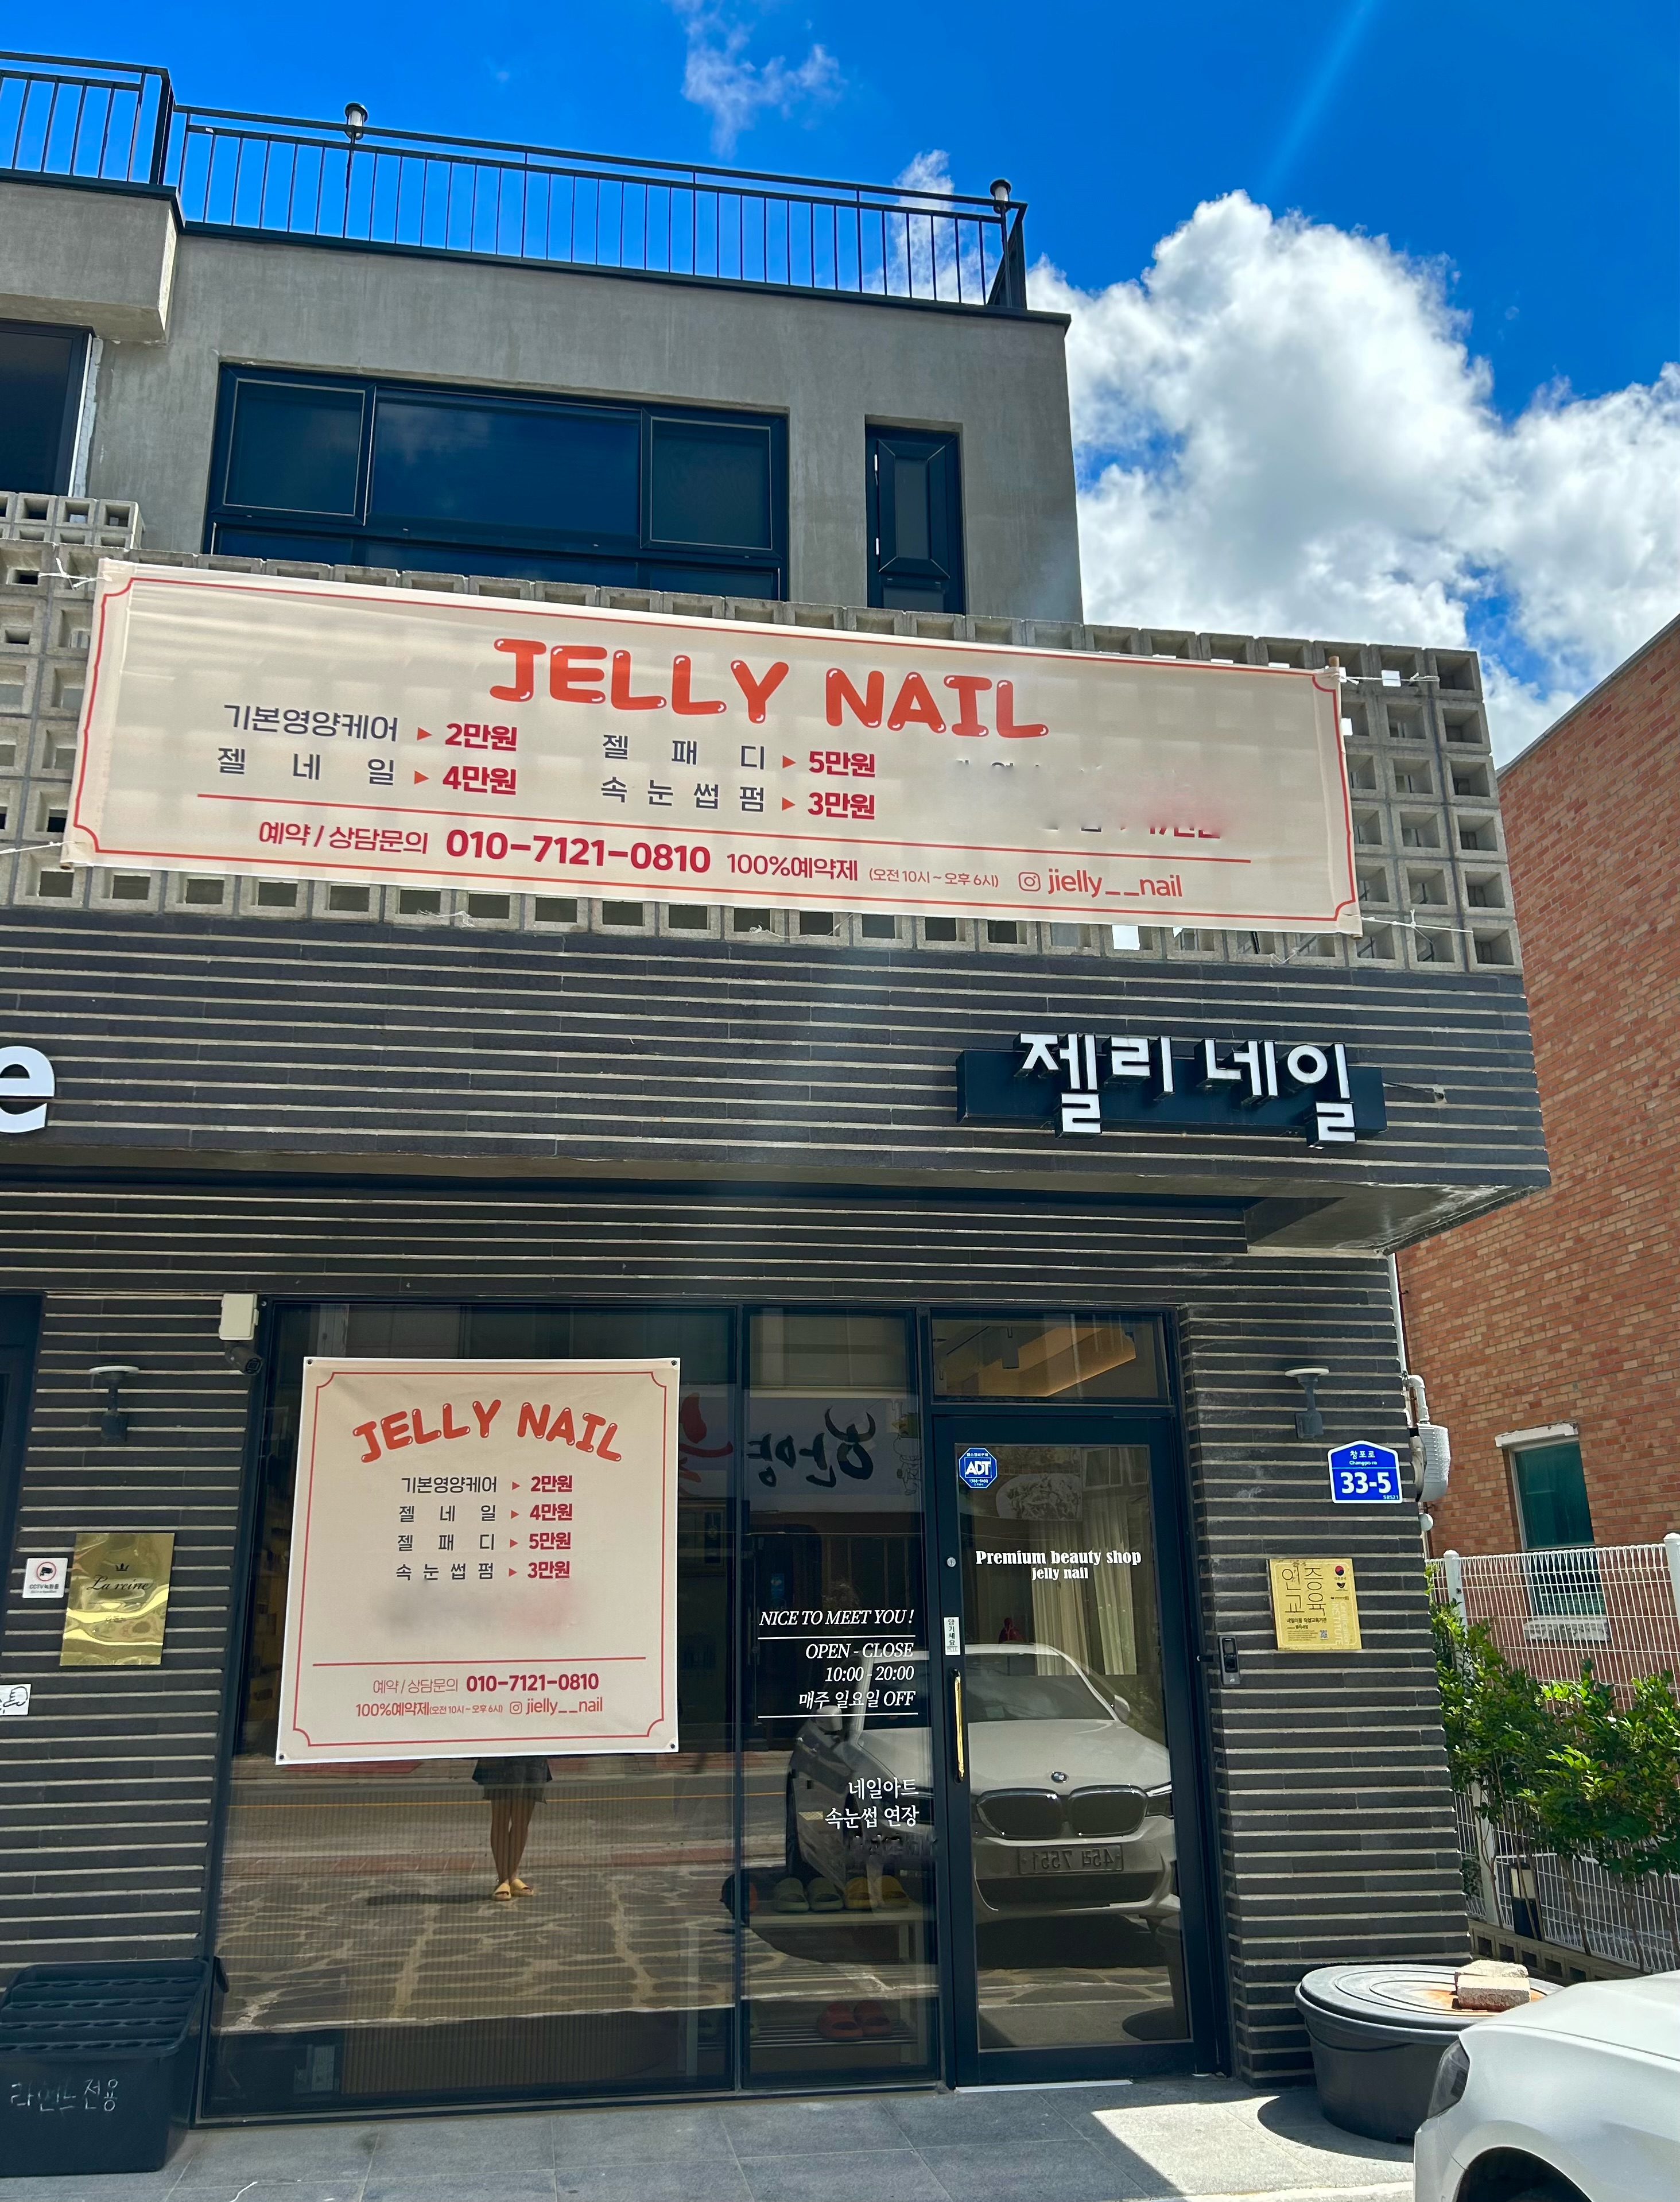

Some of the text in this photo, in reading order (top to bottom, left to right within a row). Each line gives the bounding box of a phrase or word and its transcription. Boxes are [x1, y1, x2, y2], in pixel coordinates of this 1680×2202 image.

[490, 639, 1049, 738] JELLY NAIL
[224, 705, 517, 751] 기본영양케어 2만원
[603, 735, 875, 777] 젤 패 디 5만원
[218, 748, 516, 795] 젤 네 일 4만원
[808, 792, 874, 820] 3만원
[259, 822, 311, 846] 예약
[329, 827, 428, 854] 상담문의
[446, 831, 711, 873] 010-7121-0810
[727, 854, 858, 881] 100%예약제
[870, 868, 899, 882] (오전
[902, 871, 929, 883] 10시
[945, 873, 970, 885] 오후
[974, 875, 998, 887] 6시)
[0, 1046, 55, 1133] e
[1020, 1033, 1356, 1143] 젤리 네일
[352, 1399, 501, 1463] JELLY
[517, 1402, 621, 1461] NAIL
[1350, 1451, 1376, 1459] 창포로
[965, 1461, 991, 1475] ADT
[402, 1475, 572, 1493] 기본영양케어 2만원
[1340, 1472, 1391, 1494] 33-5
[399, 1504, 572, 1522] 젤 네 일 4만원
[398, 1532, 571, 1551] 젤 패 디 5만원
[976, 1550, 1142, 1566] Premium beauty shop
[397, 1561, 569, 1580] 속 눈 썹 펌 3만원
[1033, 1567, 1089, 1581] jelly nail
[1282, 1565, 1324, 1591] 인증
[86, 1575, 154, 1590] La reine
[1285, 1592, 1326, 1616] 교육
[759, 1611, 799, 1625] NICE
[802, 1611, 823, 1625] TO
[825, 1610, 872, 1624] MEET
[875, 1610, 907, 1623] YOU
[806, 1643, 852, 1658] OPEN
[863, 1643, 914, 1658] CLOSE
[373, 1680, 398, 1693] 예약
[408, 1678, 457, 1693] 상담문의
[467, 1673, 599, 1692] 010-7121-0810
[825, 1667, 864, 1681] 10:00
[875, 1666, 914, 1680] 20:00
[800, 1690, 915, 1709] 매주 일요일 OFF
[849, 1777, 918, 1800] 네일아트
[825, 1805, 919, 1829] 속눈썹 연장
[84, 2079, 118, 2112] 전용
